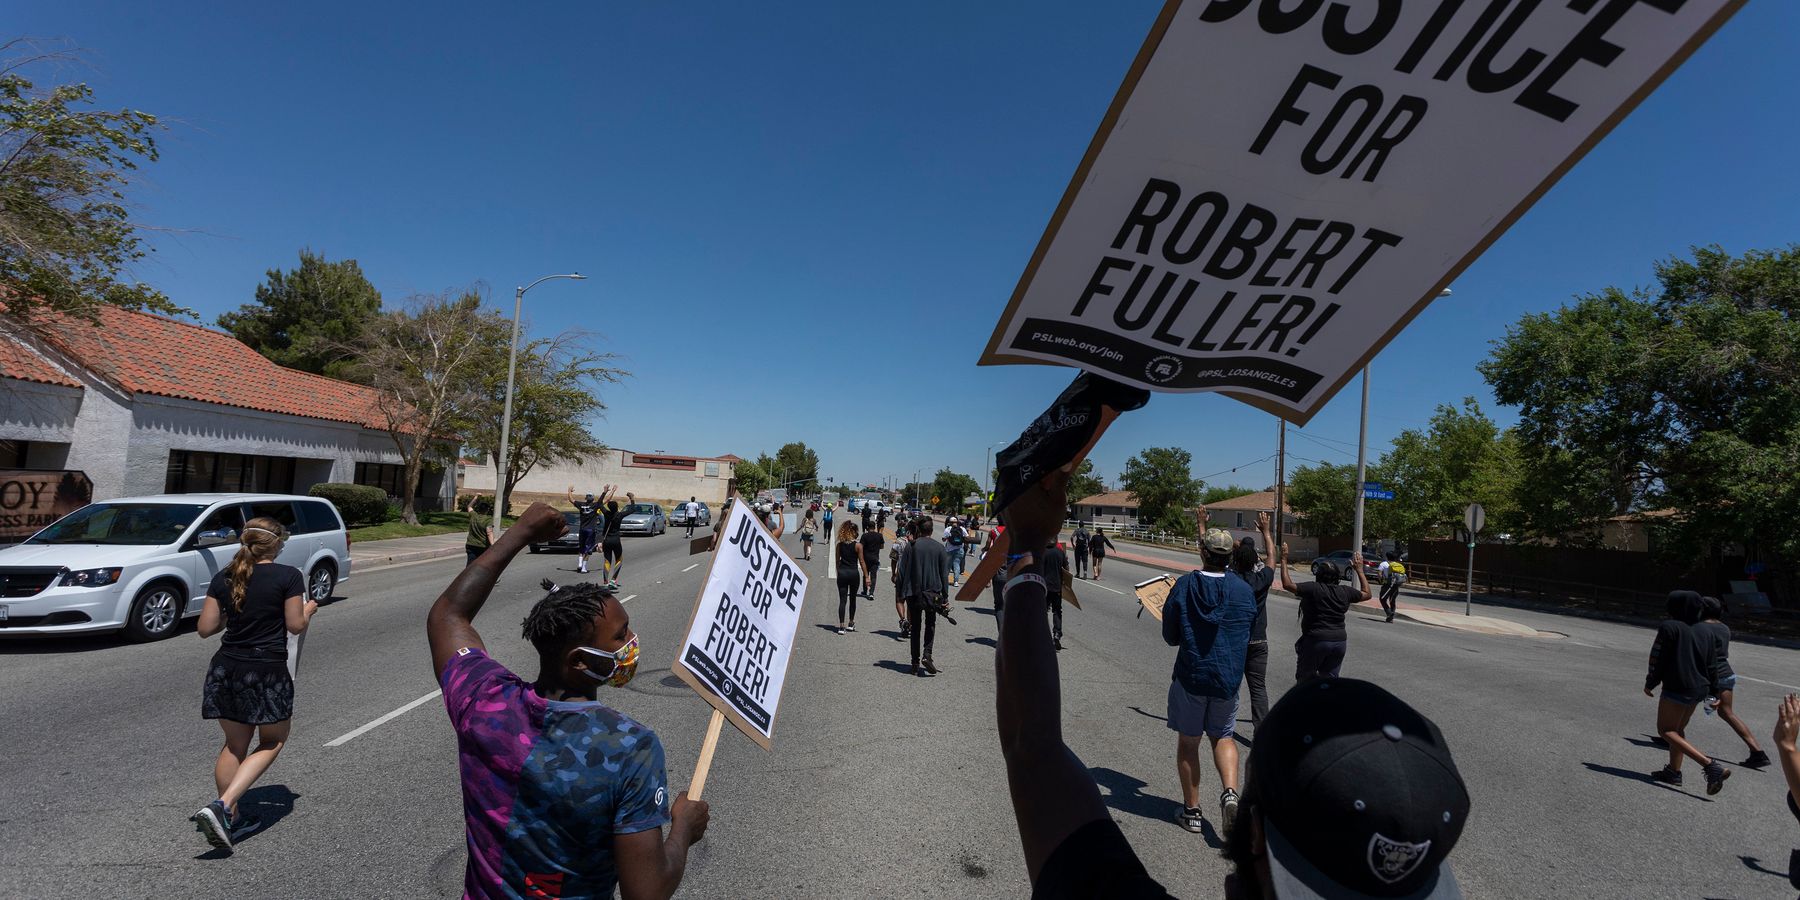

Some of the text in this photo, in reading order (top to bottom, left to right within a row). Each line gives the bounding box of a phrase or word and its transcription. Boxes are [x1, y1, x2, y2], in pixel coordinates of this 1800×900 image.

[1248, 63, 1428, 182] FOR
[1110, 178, 1404, 295] ROBERT
[1031, 332, 1124, 362] PSLweb.org/join
[1070, 256, 1341, 358] FULLER!
[1197, 368, 1297, 389] @PSL_LOSANGELES
[729, 513, 803, 612] JUSTICE
[742, 569, 772, 620] FOR
[704, 621, 770, 704] FULLER!
[715, 592, 777, 671] ROBERT
